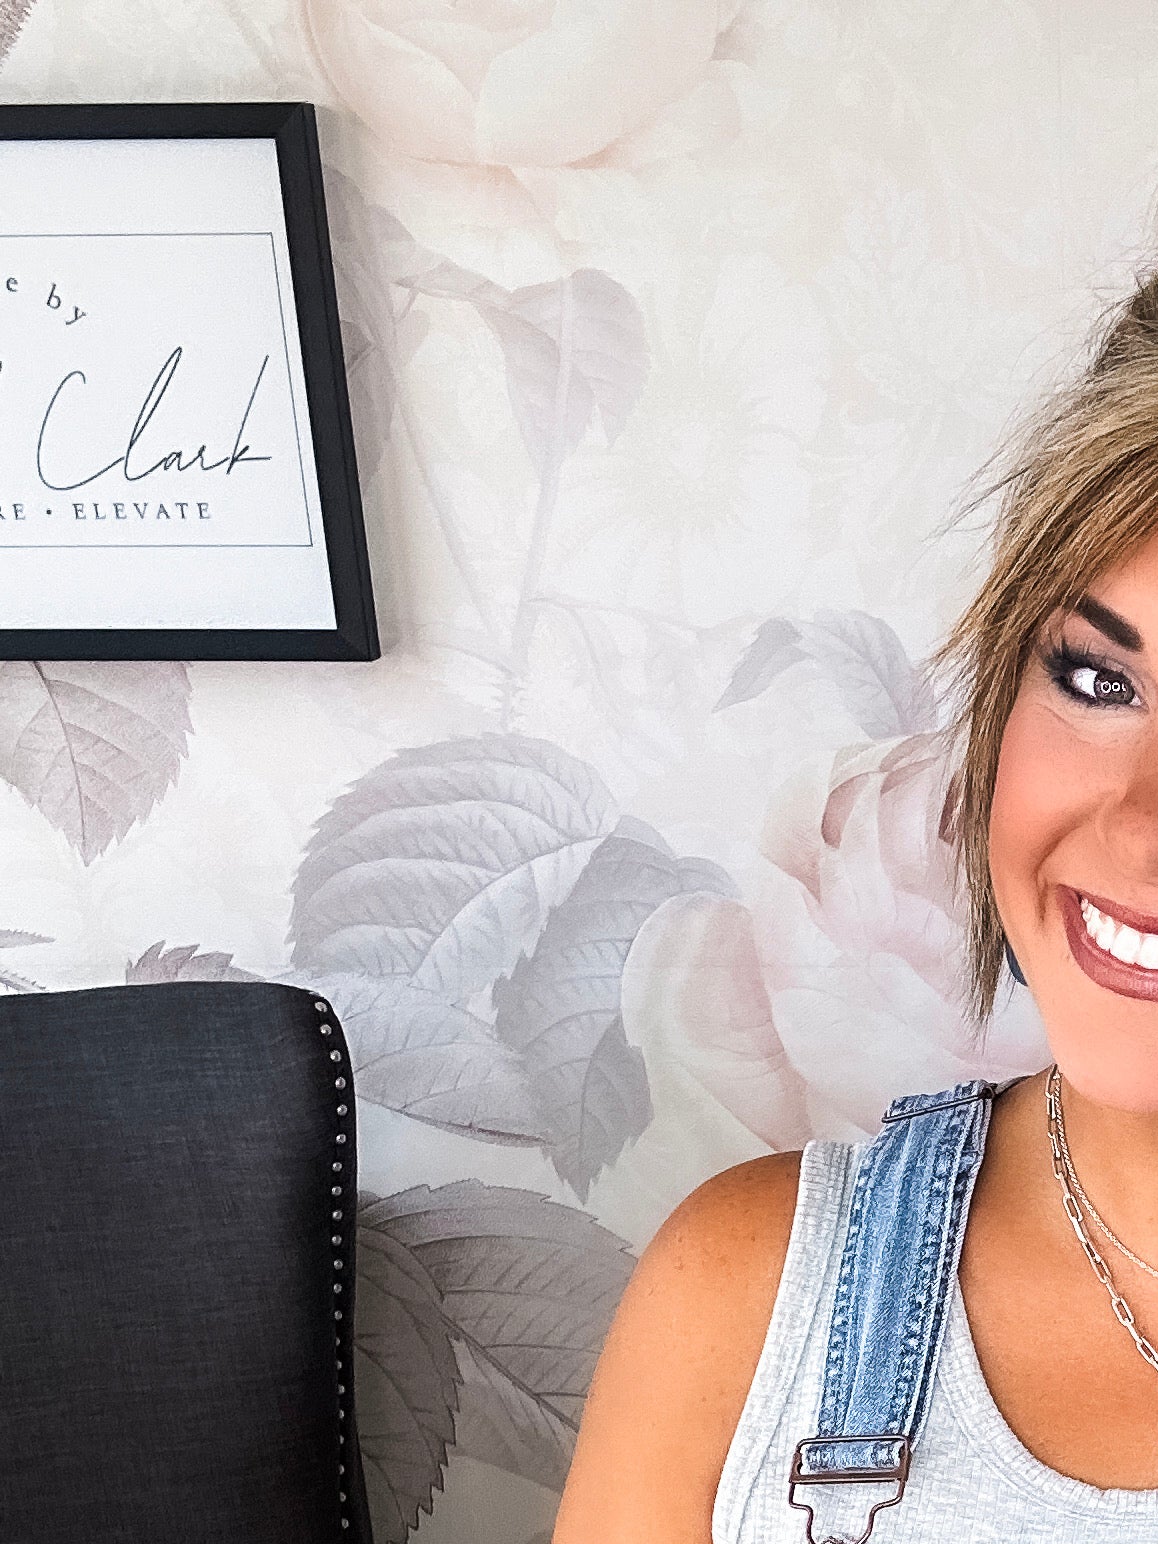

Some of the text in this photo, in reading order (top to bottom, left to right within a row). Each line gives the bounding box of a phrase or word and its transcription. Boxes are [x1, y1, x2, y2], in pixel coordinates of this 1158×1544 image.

[46, 283, 86, 325] by
[37, 347, 271, 490] Clark
[72, 502, 211, 520] ELEVATE
